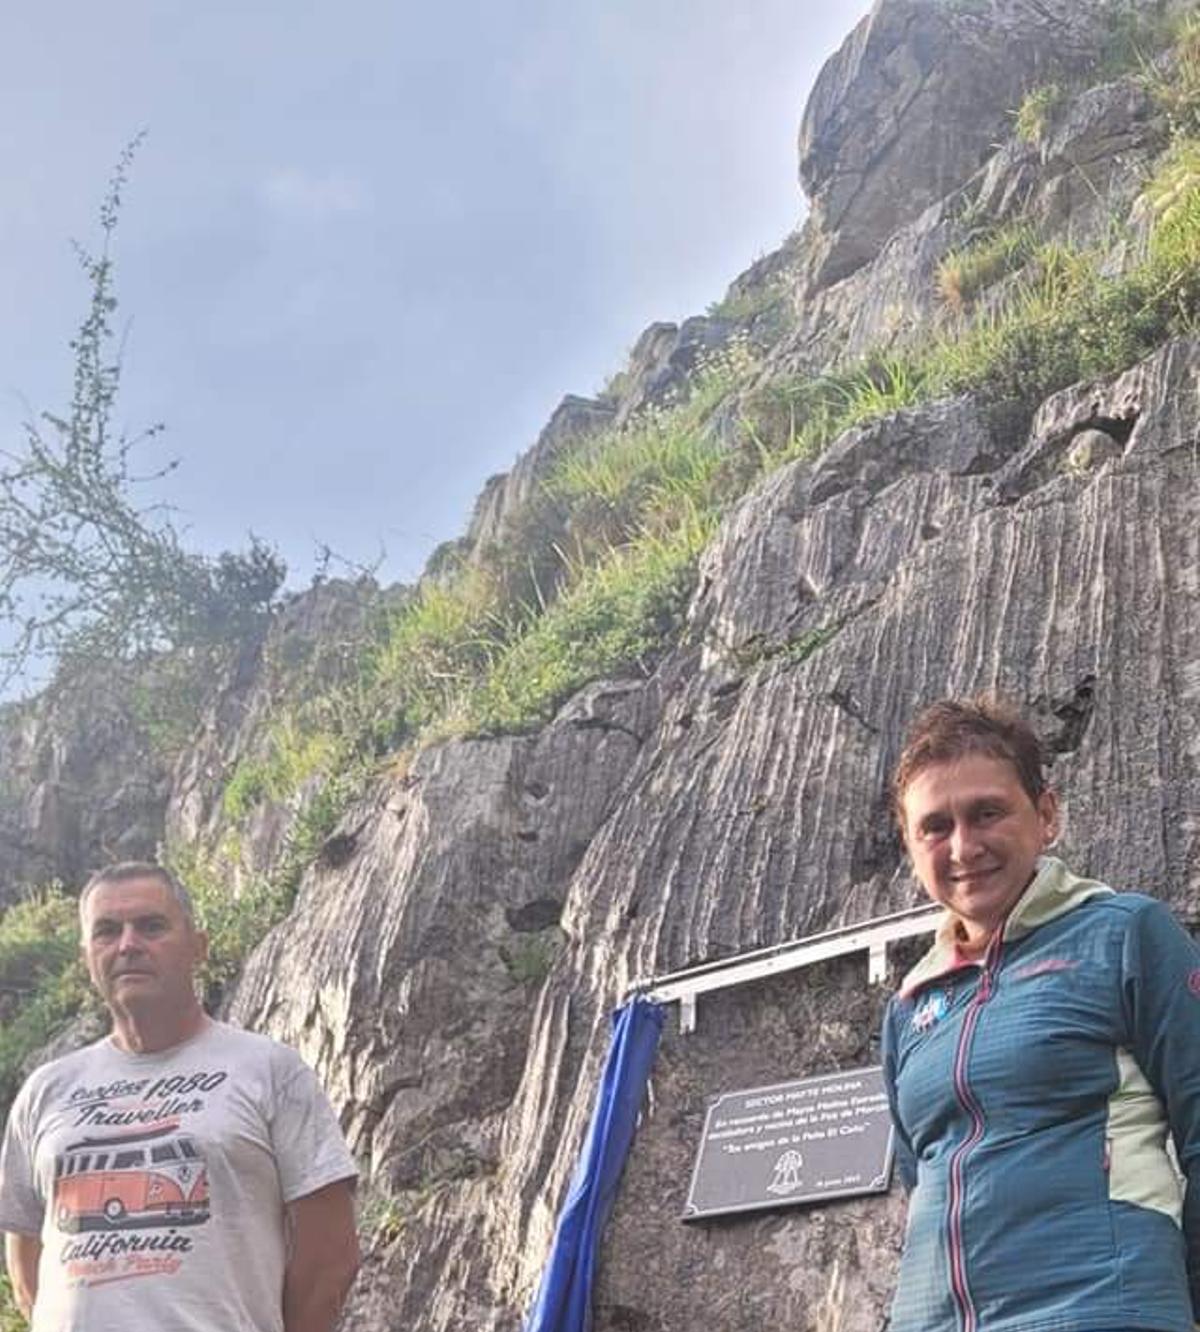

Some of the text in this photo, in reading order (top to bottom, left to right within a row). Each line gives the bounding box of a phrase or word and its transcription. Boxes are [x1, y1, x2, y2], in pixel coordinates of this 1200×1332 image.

[143, 1071, 228, 1101] 1980
[73, 1097, 205, 1127] Traveller
[60, 1229, 193, 1264] California
